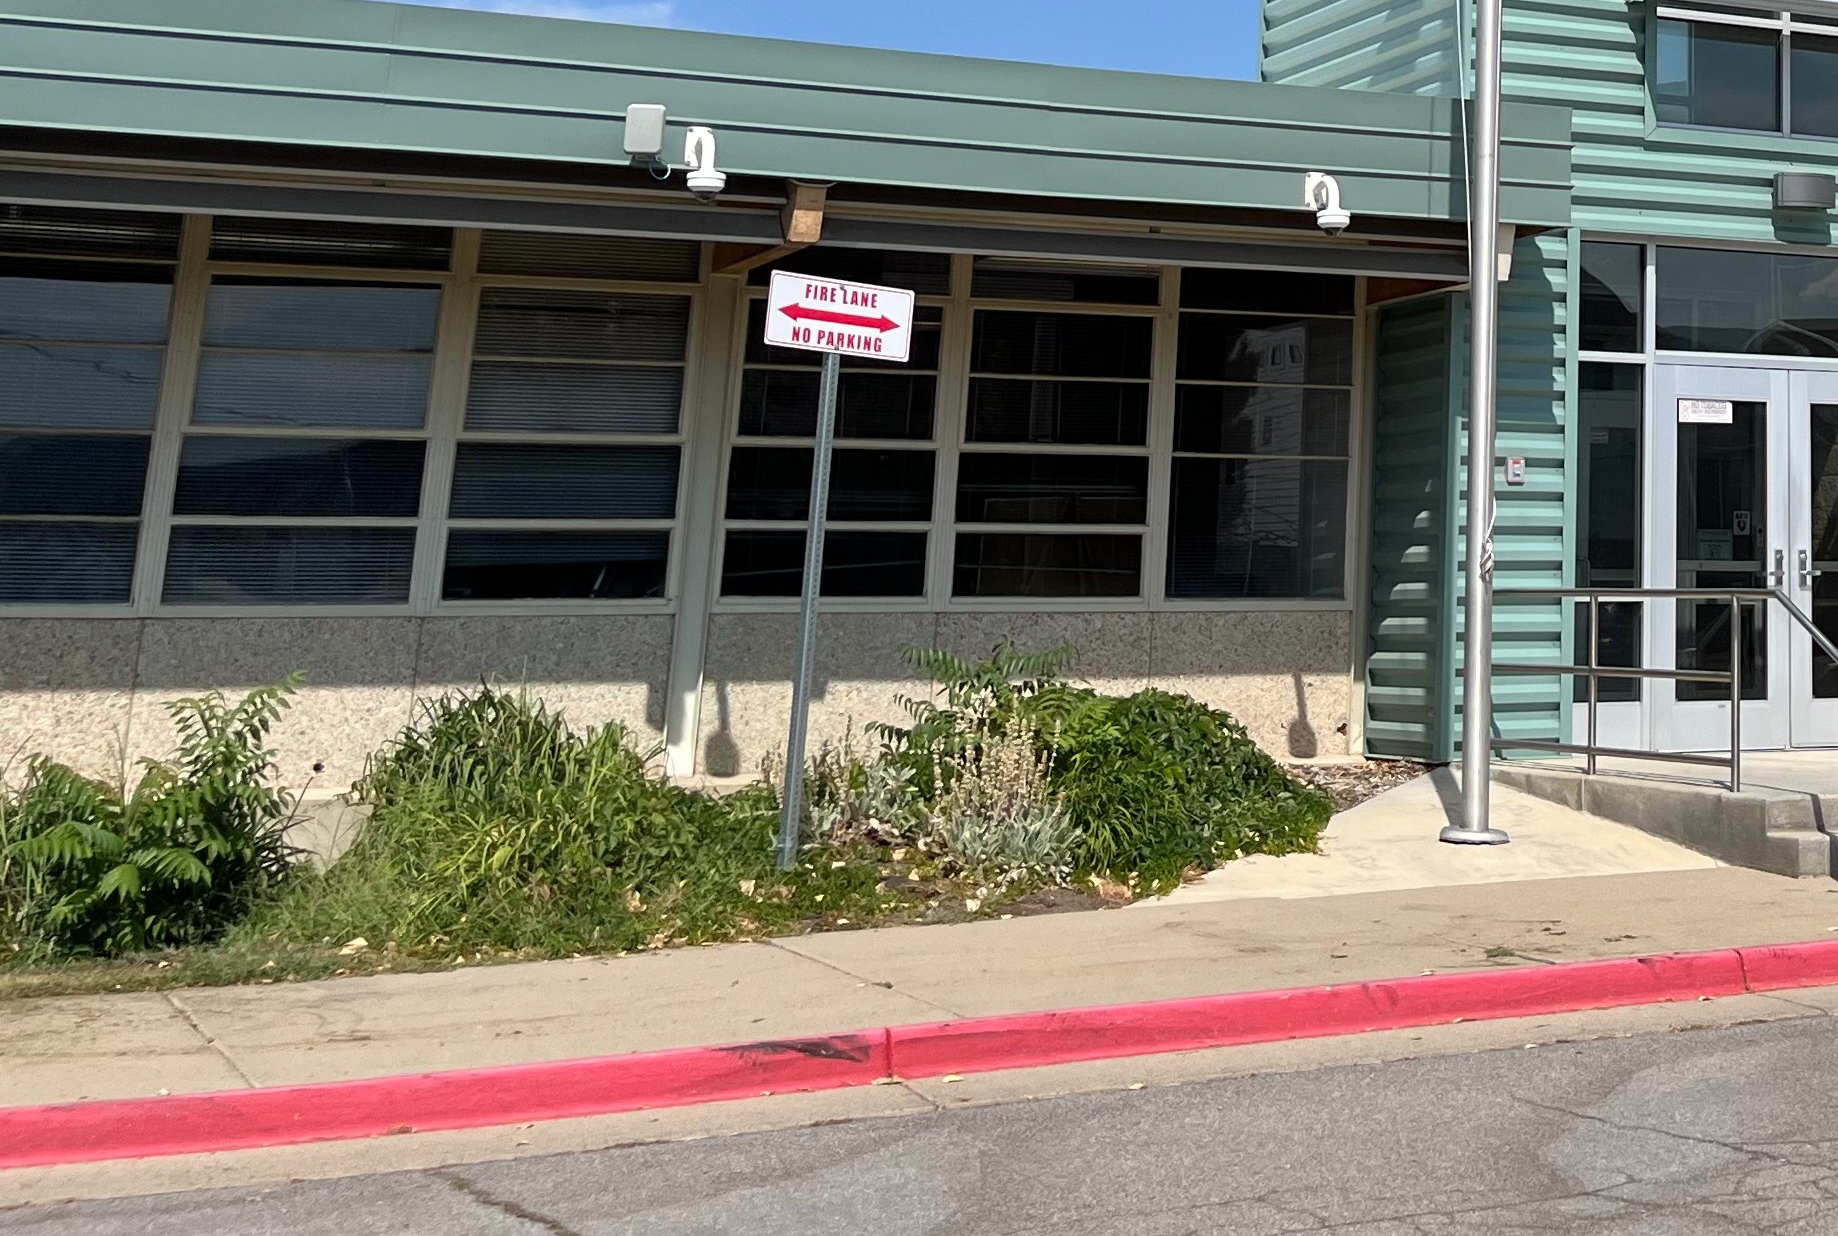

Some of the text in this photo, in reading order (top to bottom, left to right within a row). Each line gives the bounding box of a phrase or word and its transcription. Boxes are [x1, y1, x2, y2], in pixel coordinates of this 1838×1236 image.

[805, 284, 878, 309] FIRE LANE
[791, 326, 882, 353] NO PARKING
